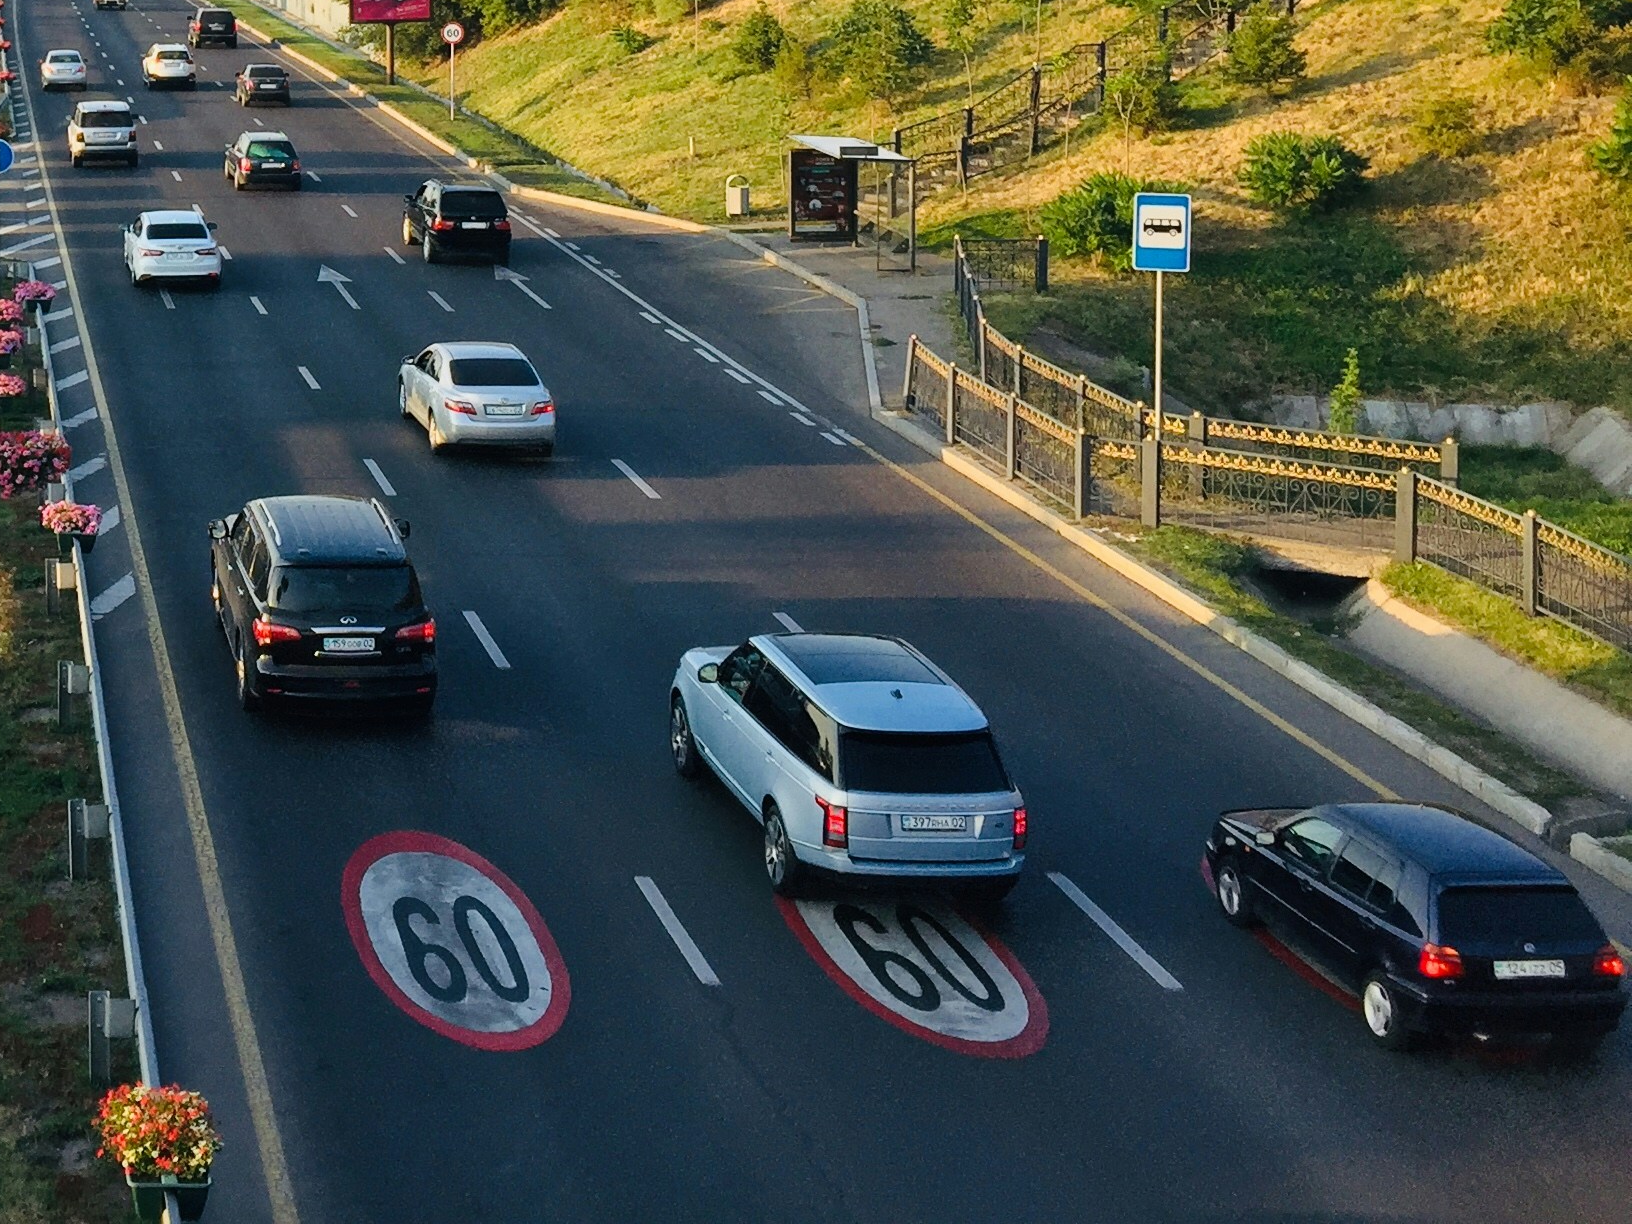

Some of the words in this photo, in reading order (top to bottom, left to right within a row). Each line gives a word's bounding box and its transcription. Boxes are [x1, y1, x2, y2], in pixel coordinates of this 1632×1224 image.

[446, 28, 460, 38] 60
[951, 817, 964, 827] 02
[392, 895, 530, 1003] 60
[833, 903, 1006, 1012] 60
